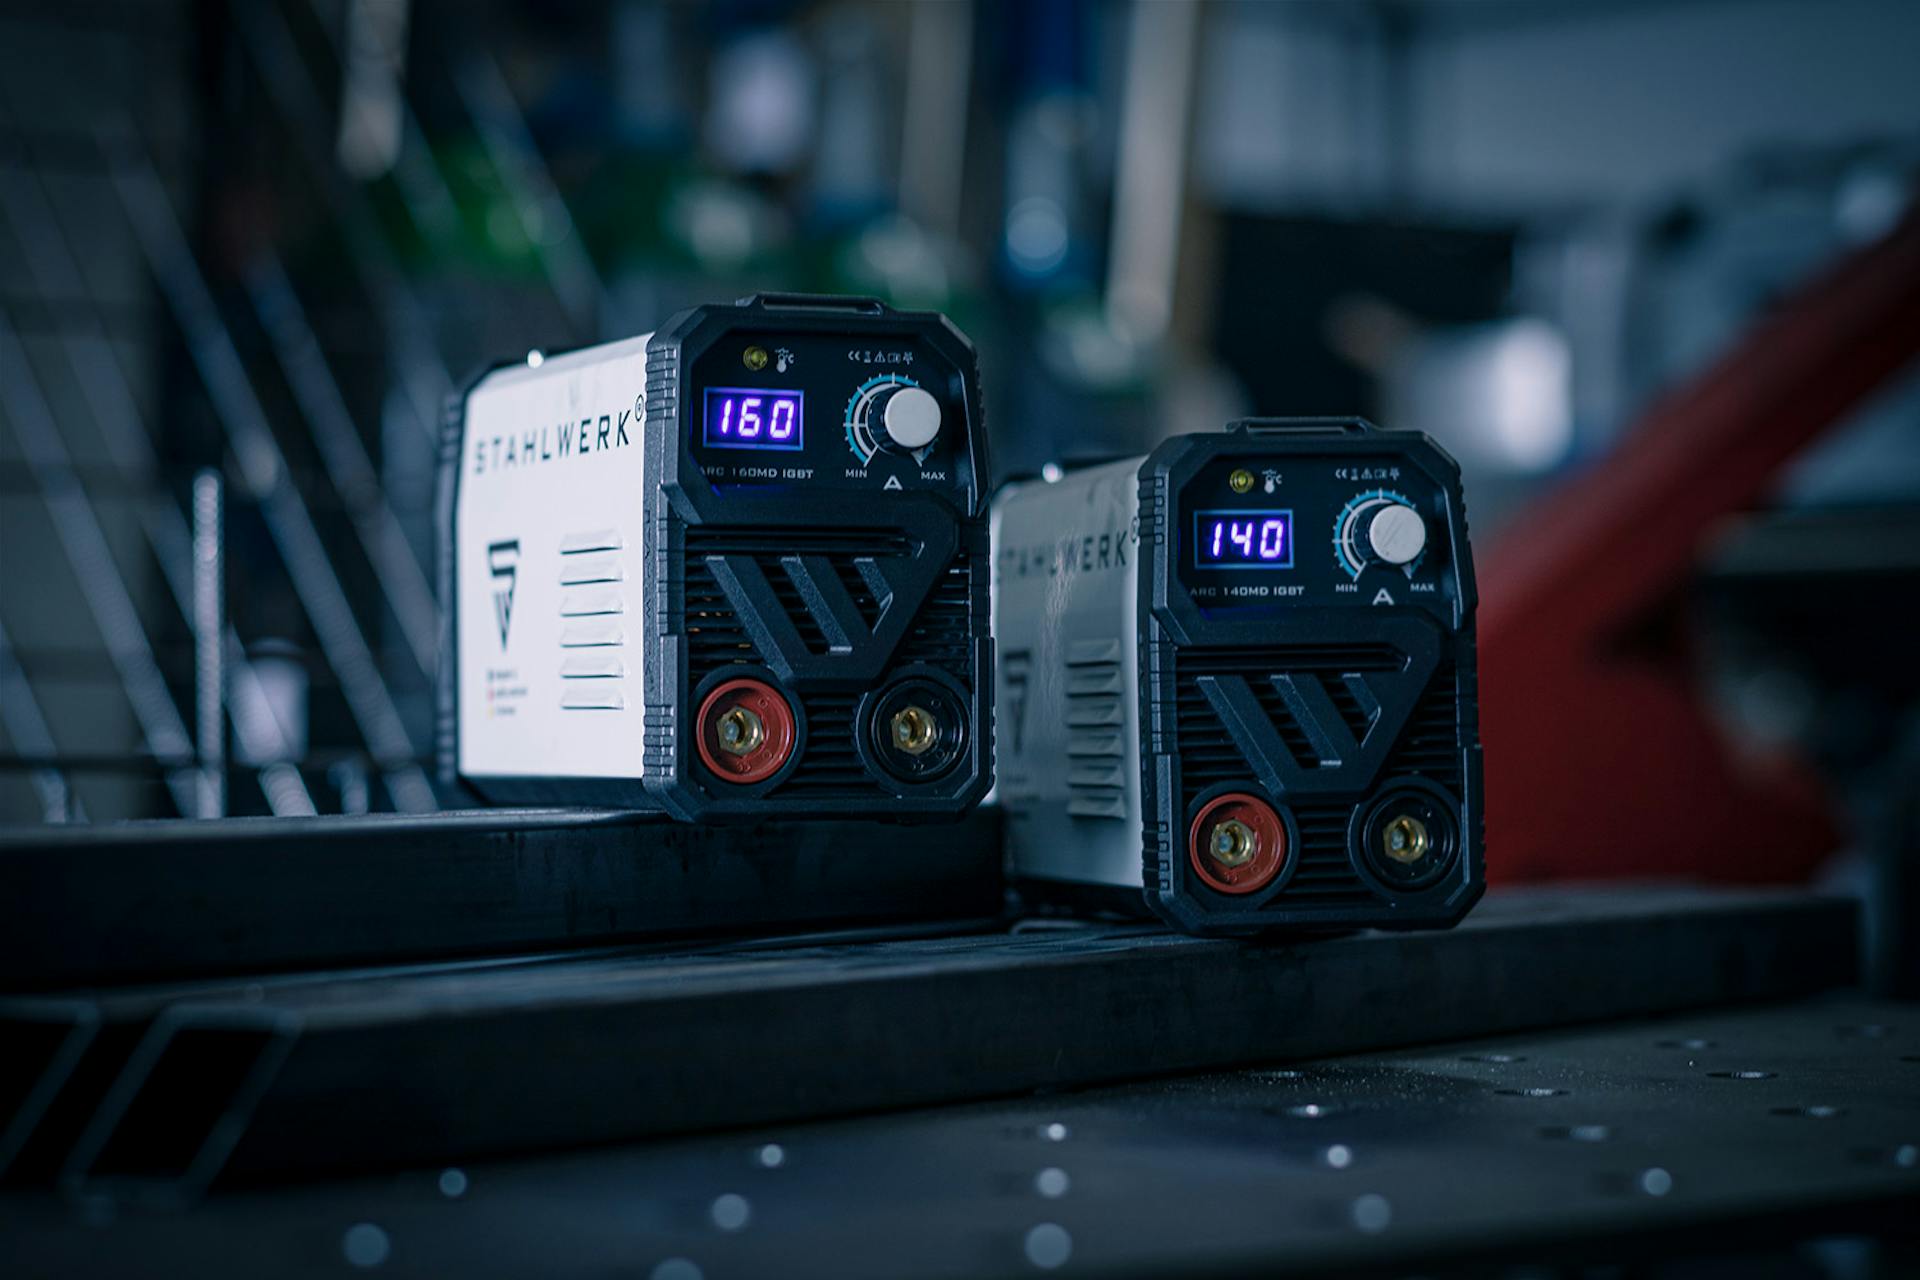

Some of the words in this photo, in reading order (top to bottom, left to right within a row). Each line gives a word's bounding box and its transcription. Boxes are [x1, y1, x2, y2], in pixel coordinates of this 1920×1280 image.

[721, 397, 795, 439] 160
[732, 466, 778, 478] 160MD
[782, 468, 814, 479] IGBT
[845, 468, 868, 478] MIN
[920, 471, 946, 481] MAX
[882, 475, 903, 490] A
[1212, 520, 1284, 558] 140
[1223, 586, 1269, 597] 140MD
[1273, 586, 1305, 597] IGBT
[1335, 583, 1358, 593] MIN
[1410, 583, 1435, 593] MAX
[1372, 588, 1395, 606] A
